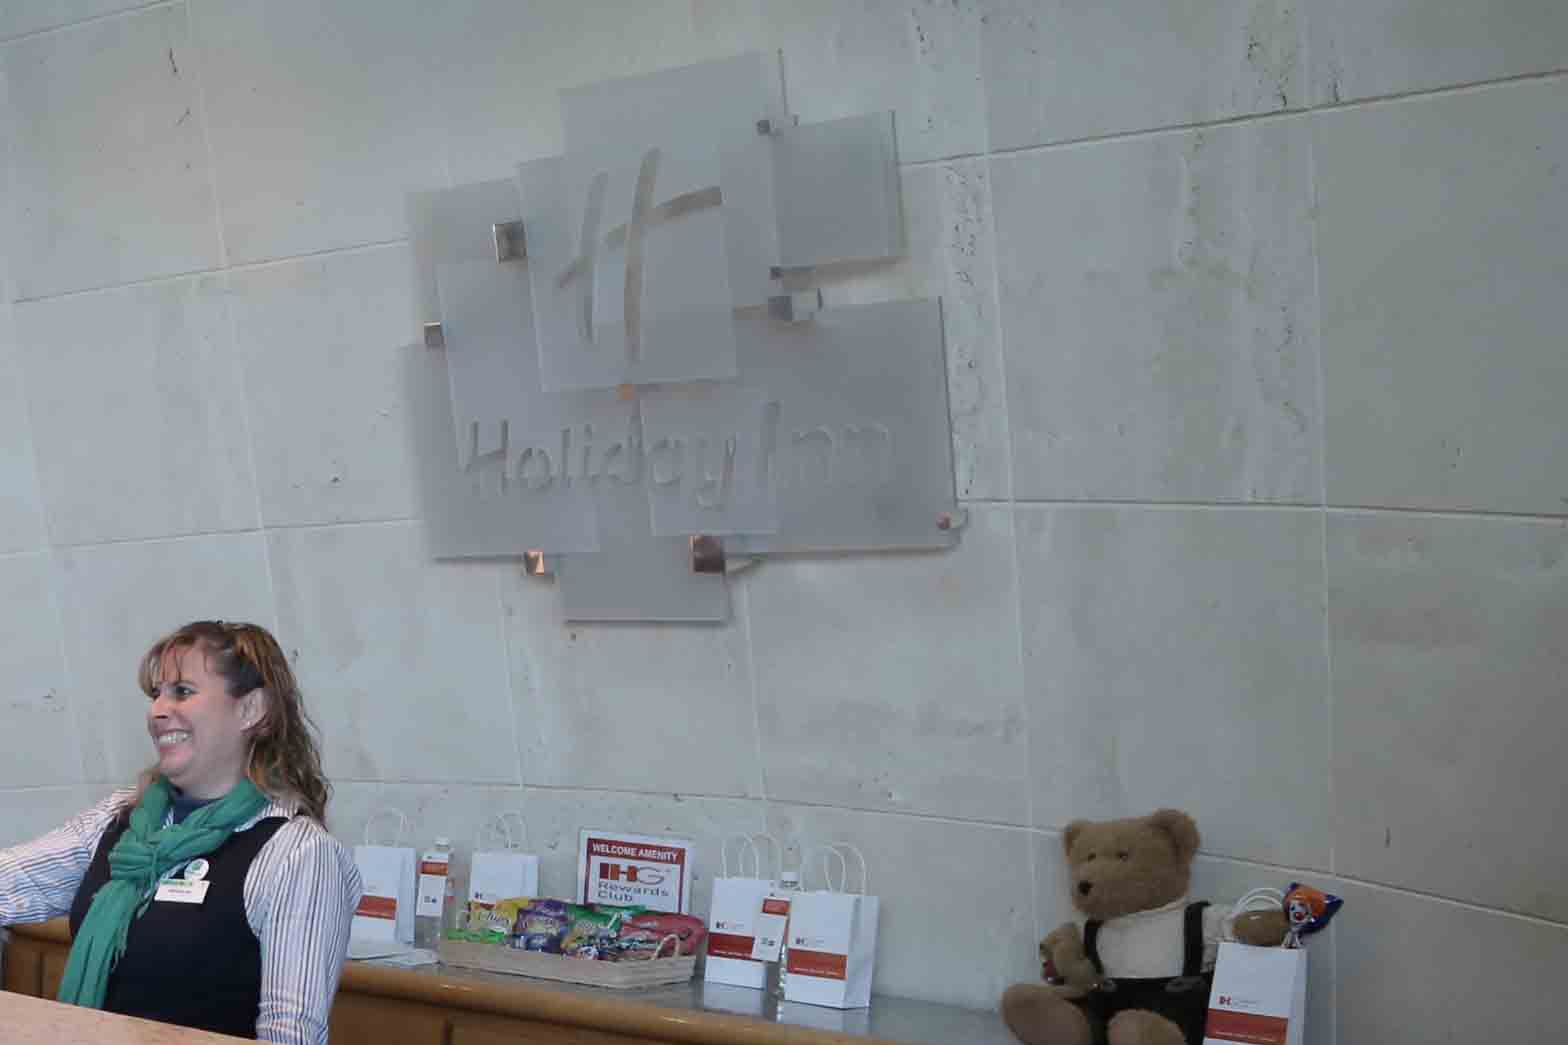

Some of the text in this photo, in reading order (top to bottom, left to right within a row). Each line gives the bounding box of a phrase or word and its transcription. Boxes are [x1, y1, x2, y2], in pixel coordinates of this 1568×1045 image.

[464, 414, 738, 512] Holiday
[591, 842, 679, 863] WELCOME AMENITY
[598, 862, 666, 886] IHG
[598, 880, 670, 897] Rewards
[598, 890, 633, 901] Club
